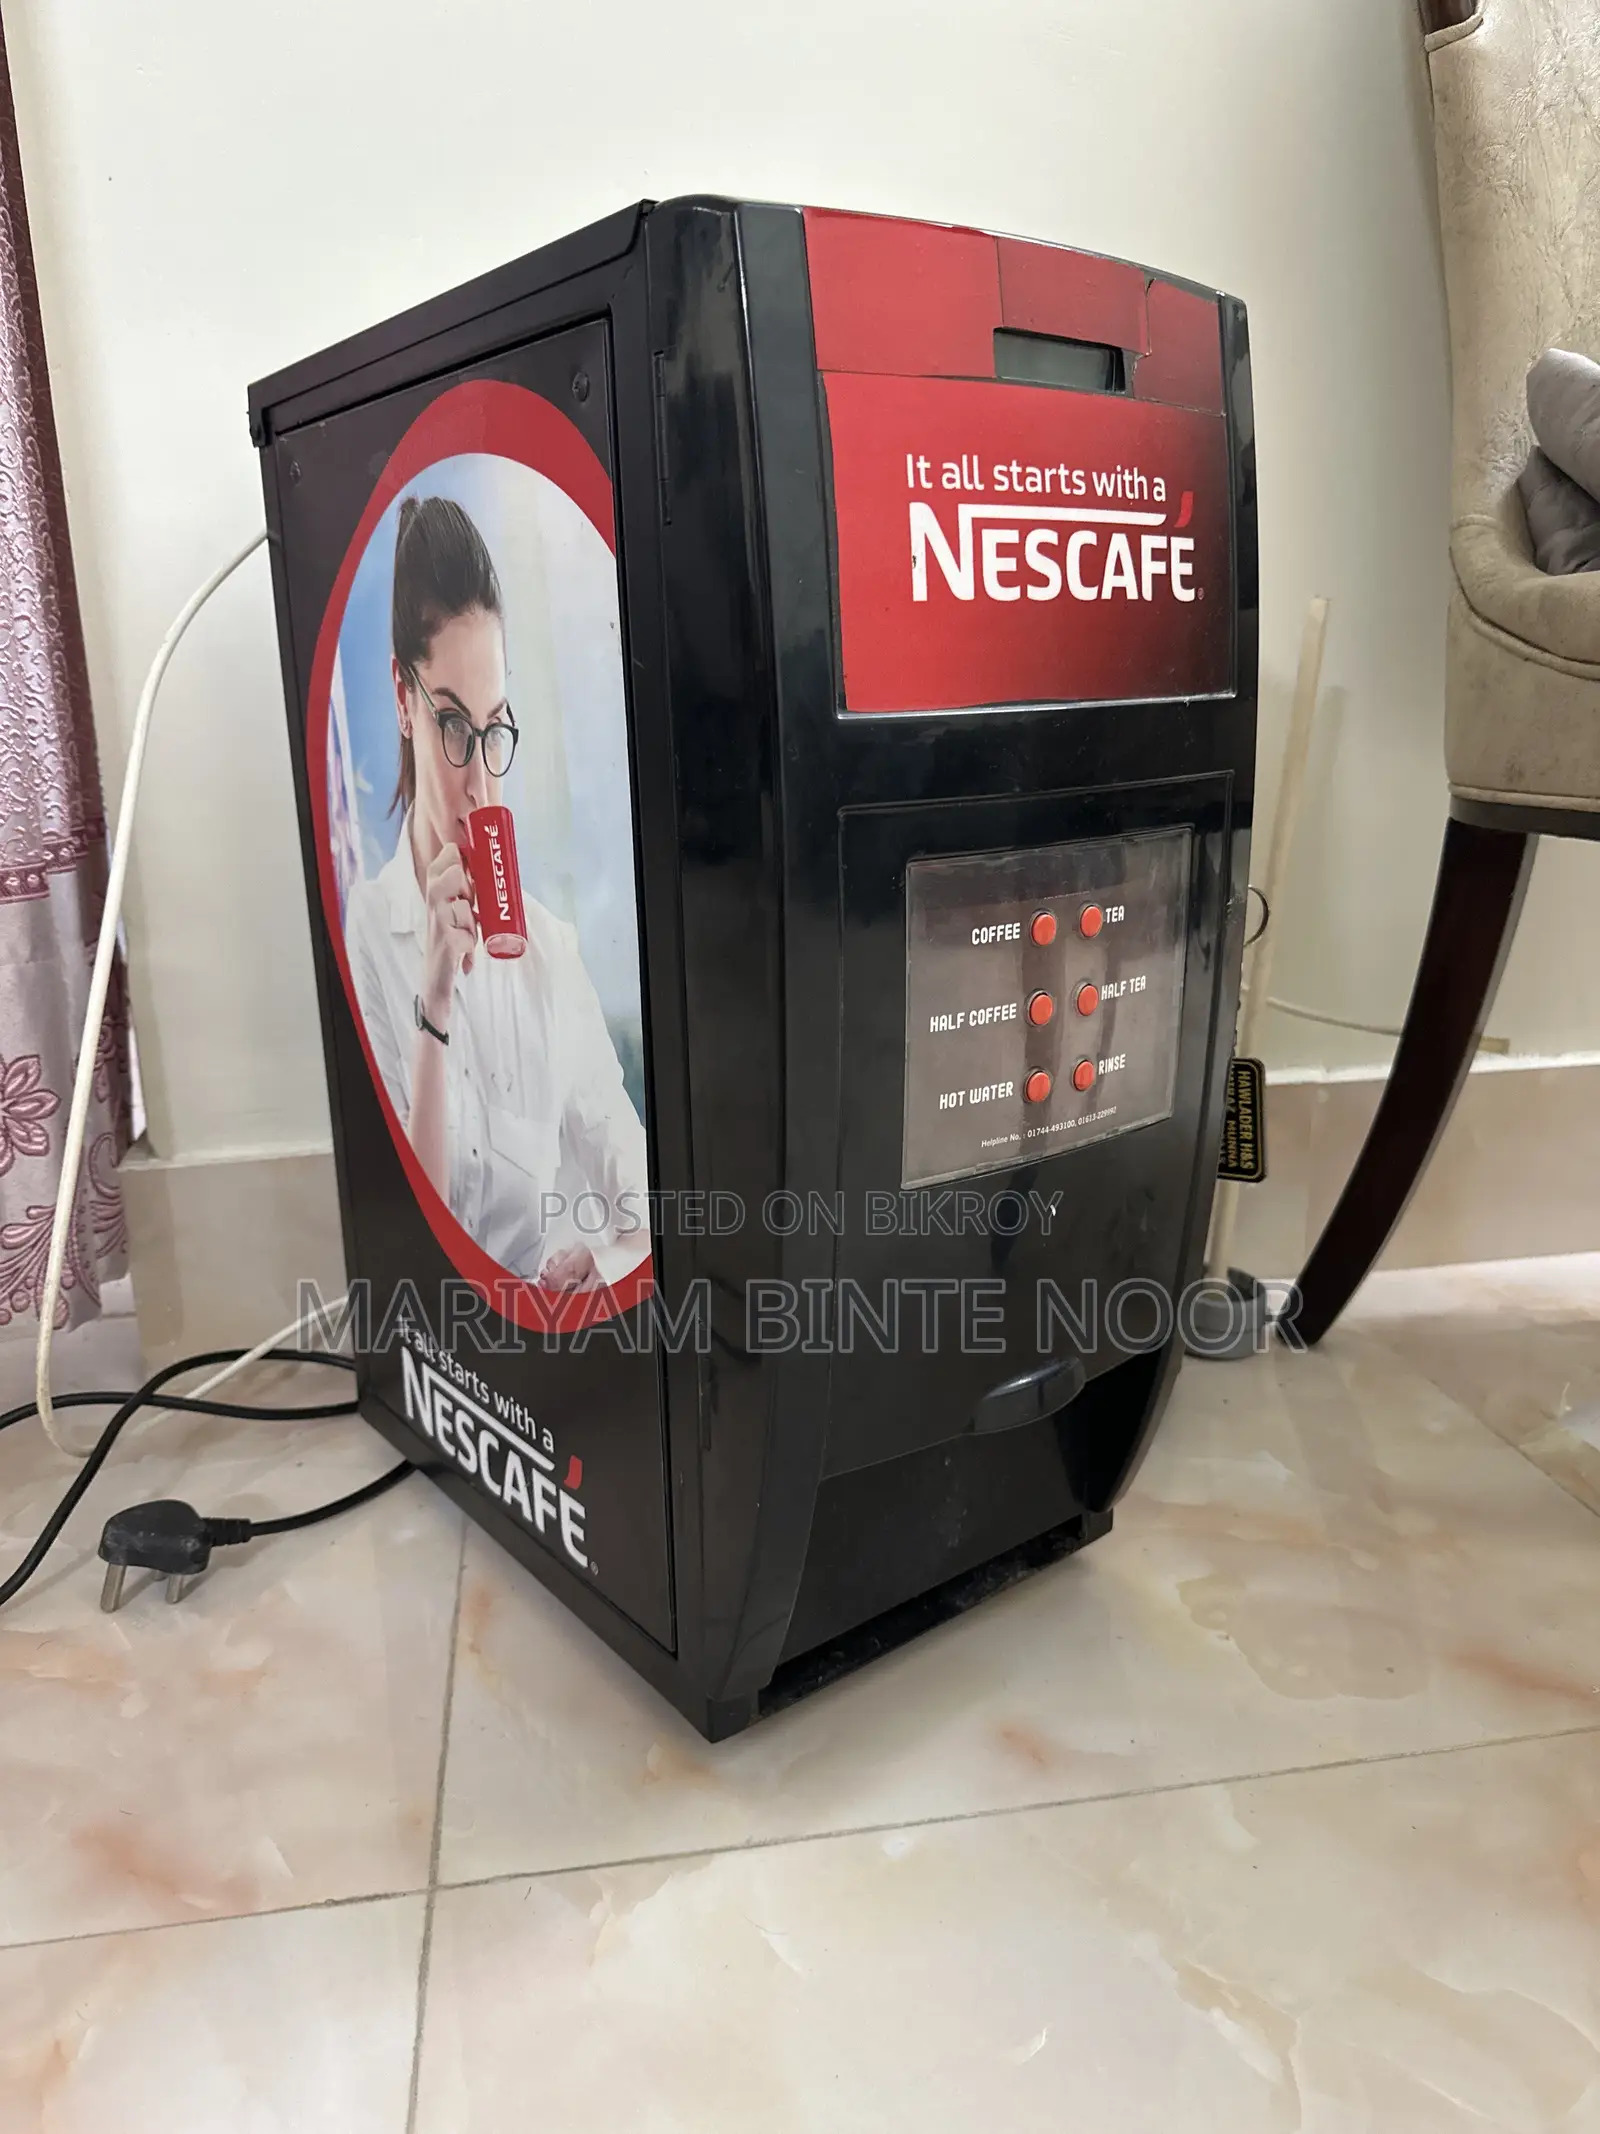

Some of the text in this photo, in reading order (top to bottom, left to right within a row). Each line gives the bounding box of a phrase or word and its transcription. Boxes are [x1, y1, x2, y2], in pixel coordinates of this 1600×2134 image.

[906, 454, 1166, 502] It all starts with a
[1105, 905, 1125, 924] TEA
[971, 922, 1021, 945] COFFEE
[1101, 975, 1147, 1001] HALF TEA
[930, 1003, 1017, 1033] HALF COFFEE
[1098, 1054, 1126, 1075] RINSE
[939, 1081, 1014, 1110] HOT WATER
[981, 1136, 1008, 1148] Helpline
[414, 1331, 436, 1363] all
[438, 1350, 490, 1405] starts
[494, 1391, 537, 1441] with
[543, 1427, 555, 1453] a
